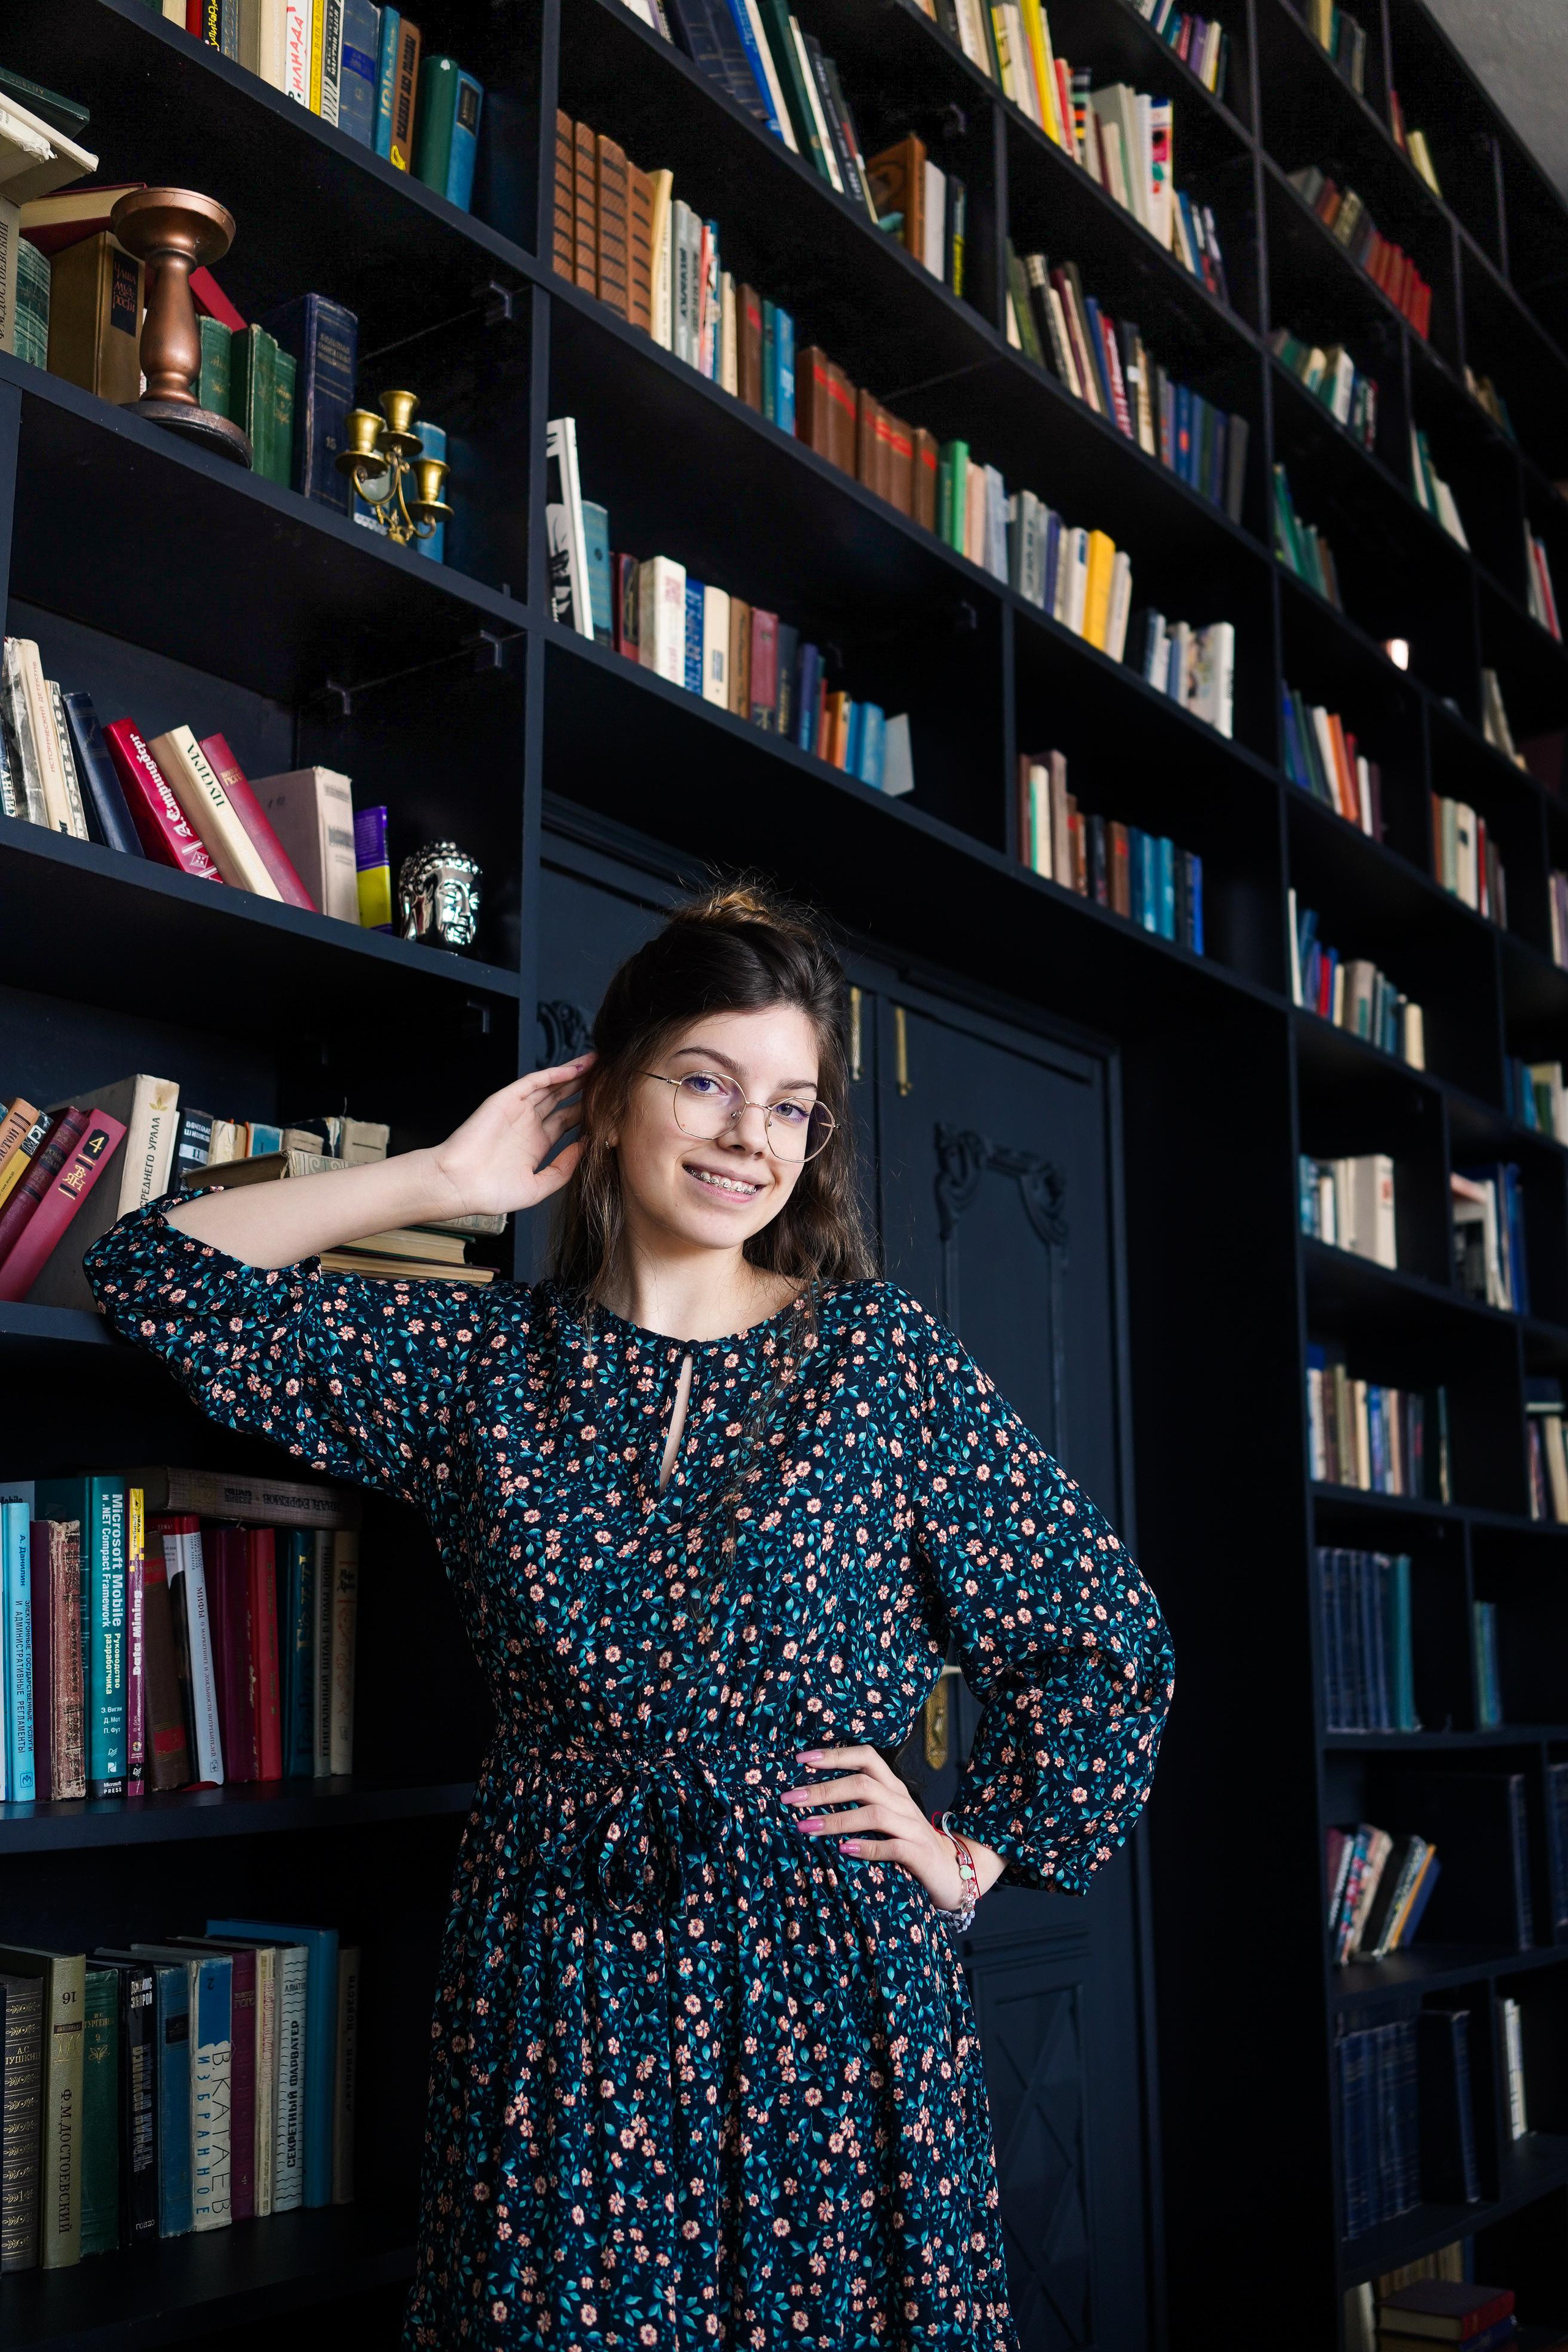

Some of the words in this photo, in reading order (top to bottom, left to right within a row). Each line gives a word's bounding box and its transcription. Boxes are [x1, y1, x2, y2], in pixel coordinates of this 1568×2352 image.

[290, 16, 304, 92] ИЛИАДА
[32, 662, 43, 703] ДЕТЕКТИВ
[39, 706, 56, 772] ИСТОРИЧЕСКИЙ
[187, 743, 225, 807] ЦУСИМА
[89, 1136, 105, 1153] 4
[140, 1154, 155, 1207] СРЕДНЕГО
[152, 1117, 161, 1151] УРАЛА
[62, 1172, 86, 1192] ЯН
[102, 1504, 111, 1525] .NET
[262, 1493, 310, 1510] ЕФРЕМОВ
[20, 1534, 26, 1544] А.
[102, 1529, 111, 1572] Compact
[112, 1493, 123, 1570] Microsoft
[102, 1574, 111, 1627] Framework
[112, 1574, 123, 1627] Mobile
[132, 1590, 143, 1638] Mining
[15, 1611, 24, 1696] АДМИНИСТРАТИВНЫЕ
[104, 1634, 113, 1695] разработчика
[132, 1642, 141, 1676] Data
[17, 1701, 26, 1754] РЕГЛАМЕНТЫ
[347, 1975, 355, 2030] ПОВЕСТИ
[290, 2020, 300, 2087] ФАРВАТЕР
[196, 2056, 211, 2215] ИЗБРАННОЕ
[287, 2090, 298, 2168] СЕКРЕТНЫЙ
